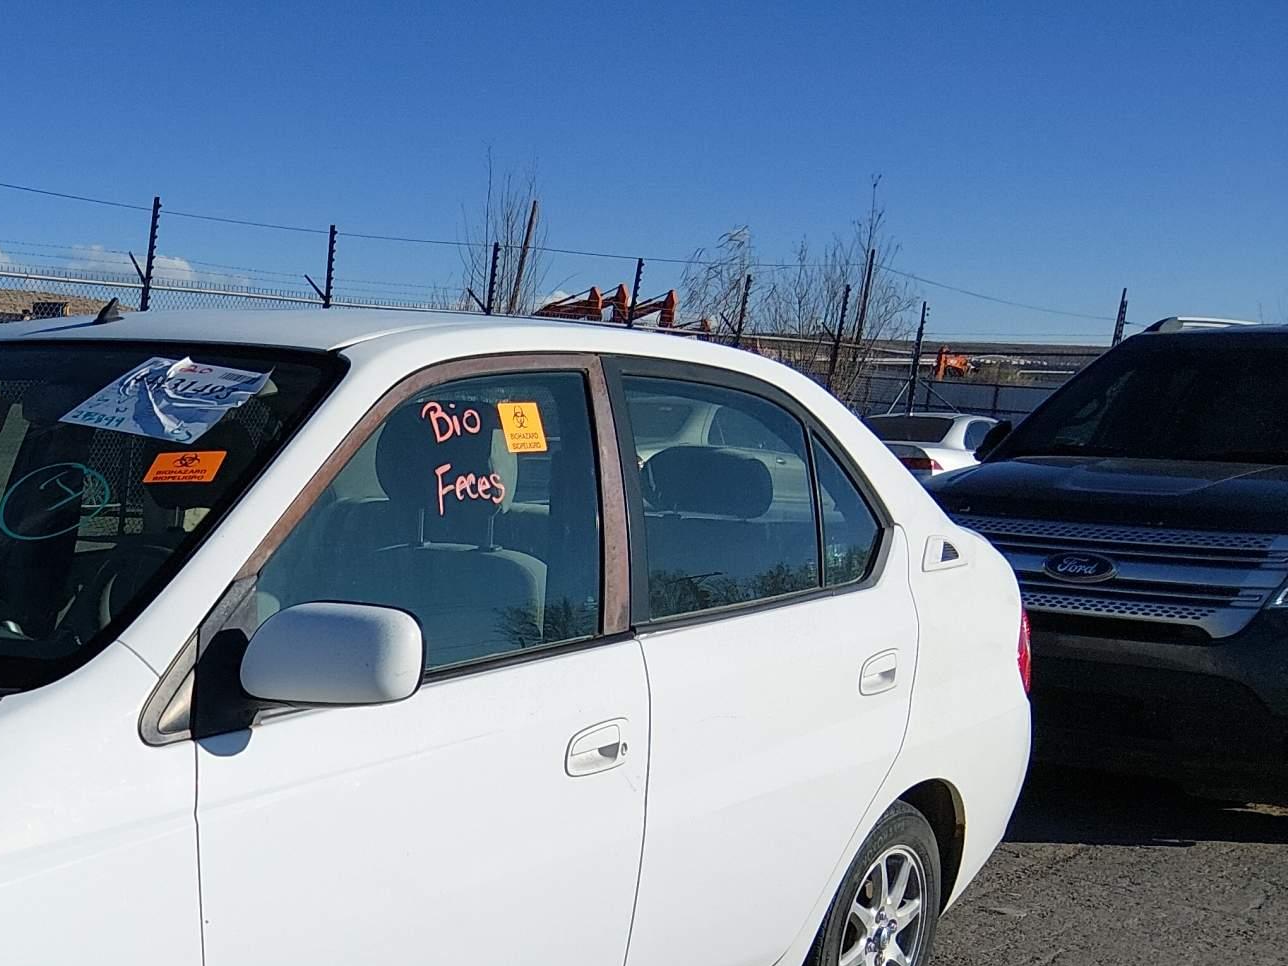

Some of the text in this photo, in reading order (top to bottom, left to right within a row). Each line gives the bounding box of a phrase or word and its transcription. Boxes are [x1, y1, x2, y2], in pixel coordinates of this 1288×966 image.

[421, 401, 481, 443] Bio
[509, 432, 539, 440] BIOHAZARD
[434, 463, 506, 516] Feces
[1057, 556, 1098, 575] Ford
